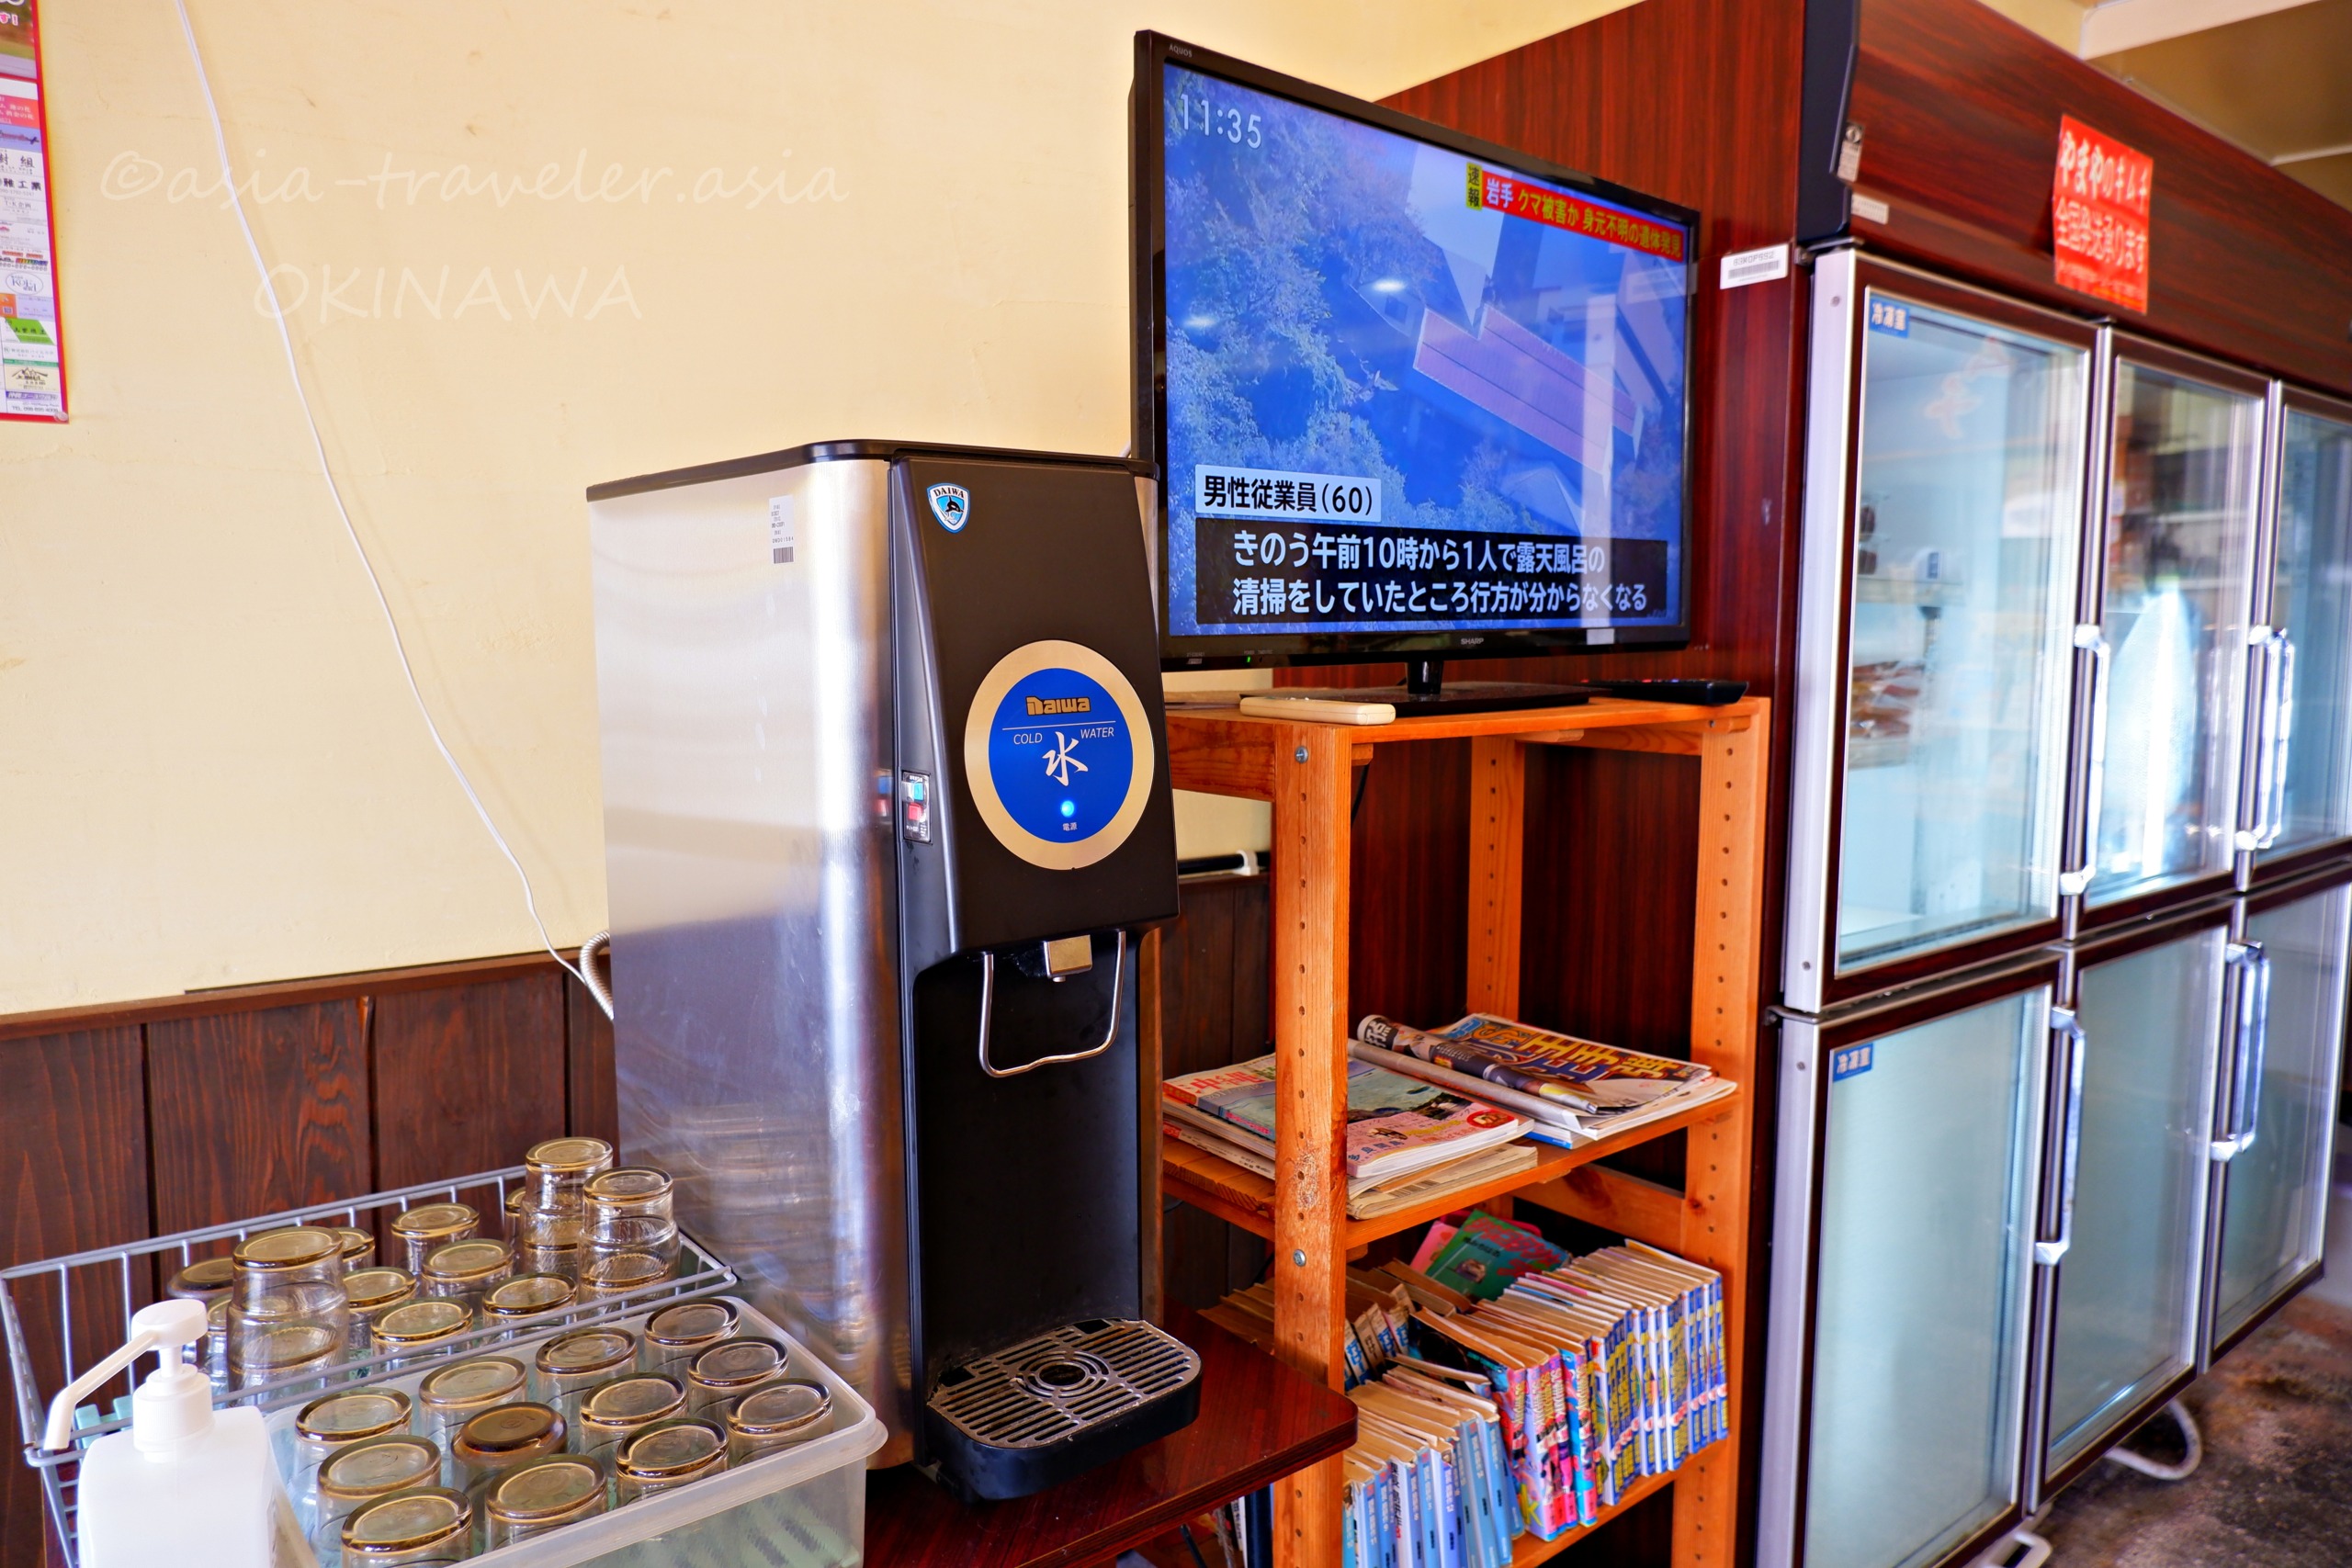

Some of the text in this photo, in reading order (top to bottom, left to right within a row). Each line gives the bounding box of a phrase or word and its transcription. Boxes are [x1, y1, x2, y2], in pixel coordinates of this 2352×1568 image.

[1169, 44, 1193, 57] AQUOS
[1181, 94, 1261, 149] 11:35
[1468, 166, 1481, 208] 速報
[1487, 178, 1514, 209] 岩手
[1518, 189, 1579, 227] クマ被害か
[933, 487, 964, 498] DAIWA
[1204, 476, 1373, 515] 男性従業員(60)
[1233, 530, 1605, 575] きのう午前10時から1人で露天風呂の
[1232, 578, 1647, 616] 清掃をしていたところ行方が分からなくなる
[1013, 727, 1114, 745] COLD WATER
[1042, 731, 1089, 786] 水
[1062, 822, 1078, 831] 電源
